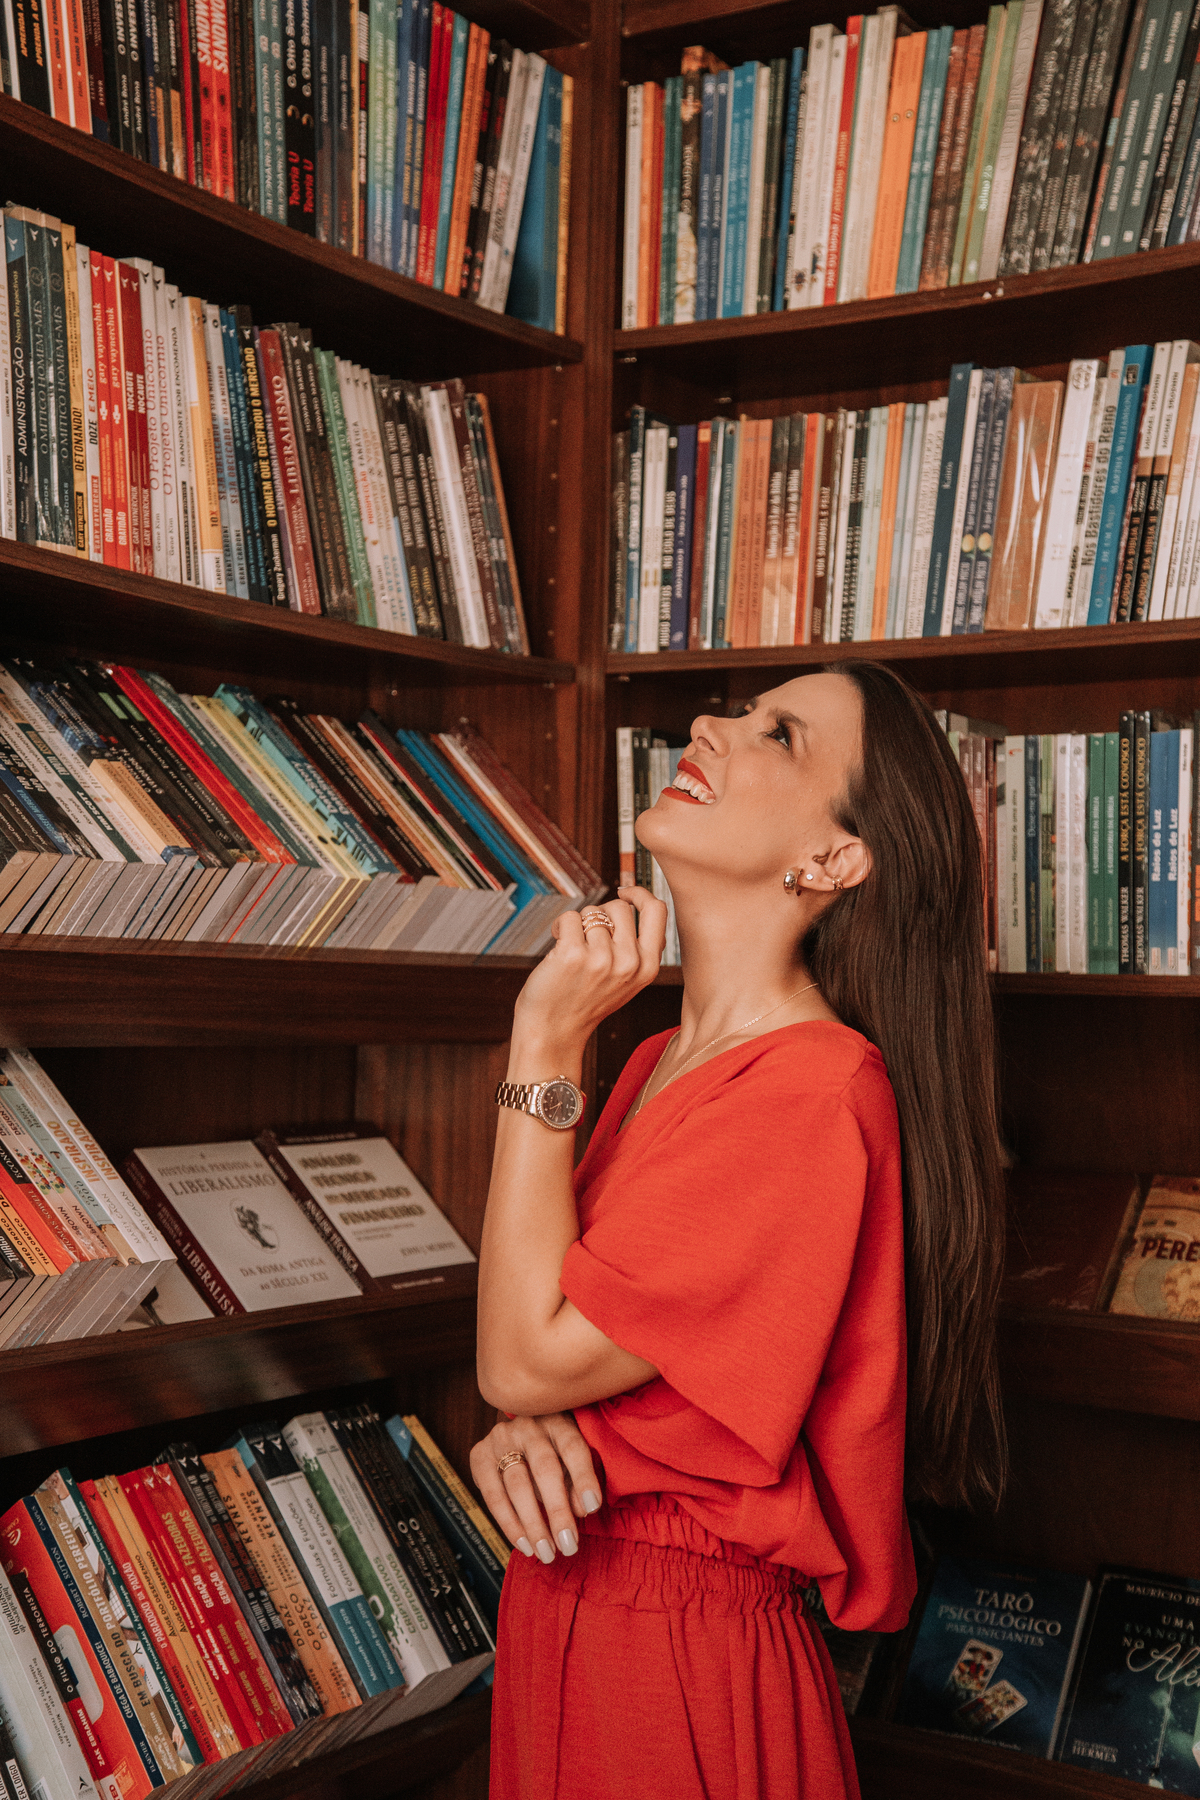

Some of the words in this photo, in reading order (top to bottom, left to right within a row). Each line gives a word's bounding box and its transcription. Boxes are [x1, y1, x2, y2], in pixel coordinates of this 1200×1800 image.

[126, 371, 135, 411] NOCAUTE
[244, 347, 260, 397] MERCADO
[13, 347, 27, 457] ADMINISTRAÇÃO
[136, 374, 146, 414] NOCAUTE
[72, 407, 84, 471] DETONANDO!
[89, 419, 98, 445] DOZE
[252, 409, 268, 458] DECIFROU
[272, 376, 300, 494] LIBERALISMO
[1098, 406, 1116, 443] Reino
[148, 417, 160, 472] Projeto
[160, 422, 172, 477] Projeto
[1096, 447, 1108, 463] do
[150, 478, 160, 490] O
[259, 459, 271, 479] QUE
[162, 483, 172, 495] O
[262, 481, 276, 518] HOMEM
[1084, 468, 1107, 537] Bastidores
[210, 510, 218, 528] 10X
[1081, 541, 1096, 566] Nos
[1152, 809, 1161, 829] Luz
[1168, 809, 1178, 829] Luz
[1152, 832, 1161, 847] de
[1168, 831, 1177, 847] de
[1152, 849, 1161, 881] Raios
[1168, 849, 1177, 881] Raios
[45, 1118, 101, 1186] INSPIRADO
[64, 1115, 120, 1184] INSPIRADO
[222, 1492, 253, 1545] KEYNES
[245, 1487, 276, 1539] KEYNES
[285, 1500, 313, 1543] Funções
[301, 1496, 330, 1538] Funções
[160, 1509, 195, 1567] FAZEDORAS
[178, 1506, 212, 1564] FAZEDORAS
[145, 1548, 173, 1600] DESEMPENHO
[190, 1572, 215, 1610] GERAÇÃO
[206, 1568, 232, 1606] GERAÇÃO
[383, 1551, 431, 1631] CRIPTOATIVOS
[21, 1586, 50, 1637] TERRORISTA
[287, 1590, 318, 1637] PREÇO
[370, 1555, 418, 1634] CRIPTOATIVOS
[976, 1588, 1034, 1612] TARÔ
[338, 1606, 352, 1626] 2019
[938, 1605, 1062, 1637] PSICOLÓGICO
[1162, 1614, 1194, 1631] UMA
[45, 1638, 57, 1654] DO
[109, 1630, 124, 1648] DO
[52, 1655, 70, 1682] FILHO
[93, 1640, 119, 1683] BABAQUICE!
[118, 1649, 143, 1688] BUSCA
[112, 1682, 123, 1694] DE
[117, 1692, 134, 1719] CHEGA
[136, 1688, 151, 1707] EM
[76, 1707, 97, 1747] EBRAHIM
[93, 1747, 105, 1766] ZAK
